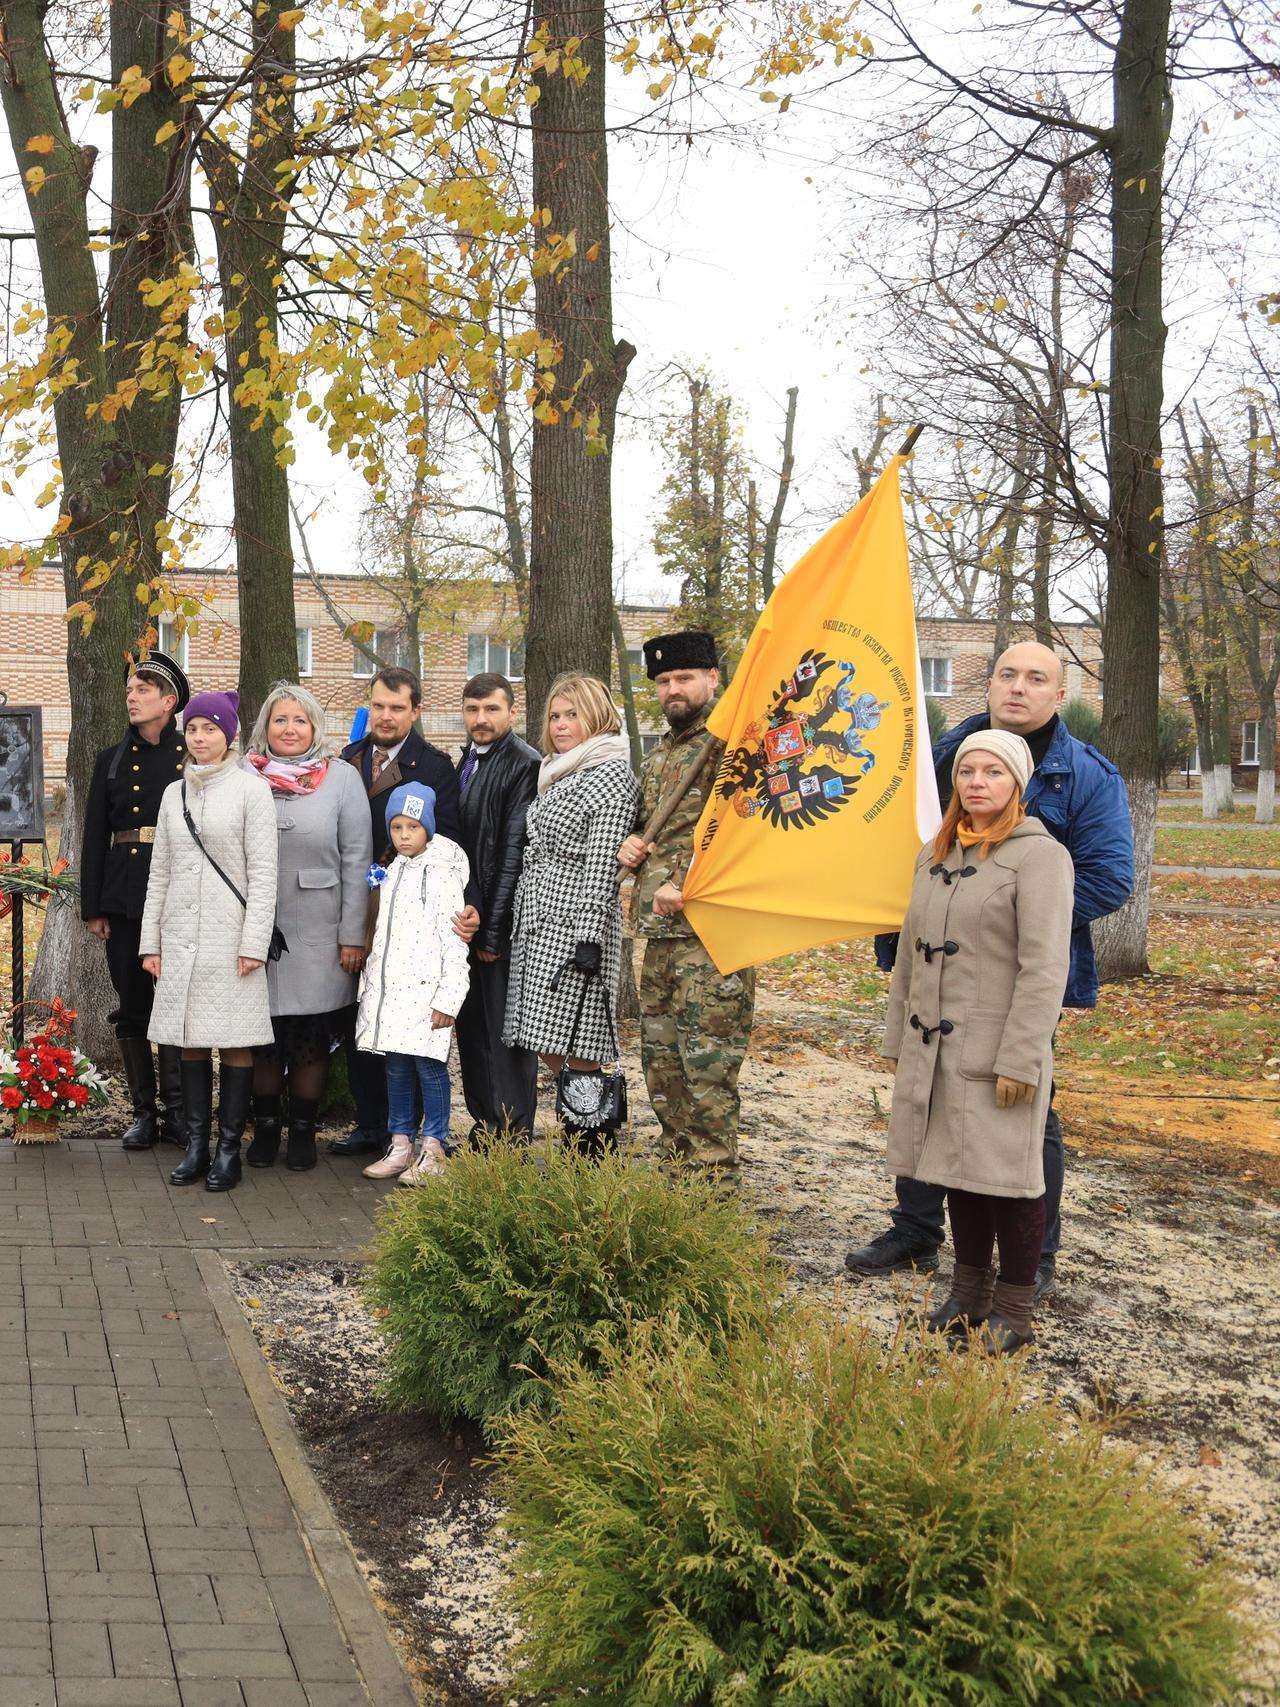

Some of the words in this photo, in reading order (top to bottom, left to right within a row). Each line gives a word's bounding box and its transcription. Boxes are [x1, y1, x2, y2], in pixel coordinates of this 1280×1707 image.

[822, 620, 862, 638] ОБЩЕСТВО
[862, 634, 894, 666] РАЗВИТИЯ
[889, 666, 911, 702] РУССКОГО
[898, 706, 914, 771] ИСТОРИЧЕСКОГО
[862, 775, 903, 824] ПРОСВЕЩЕНИЯ
